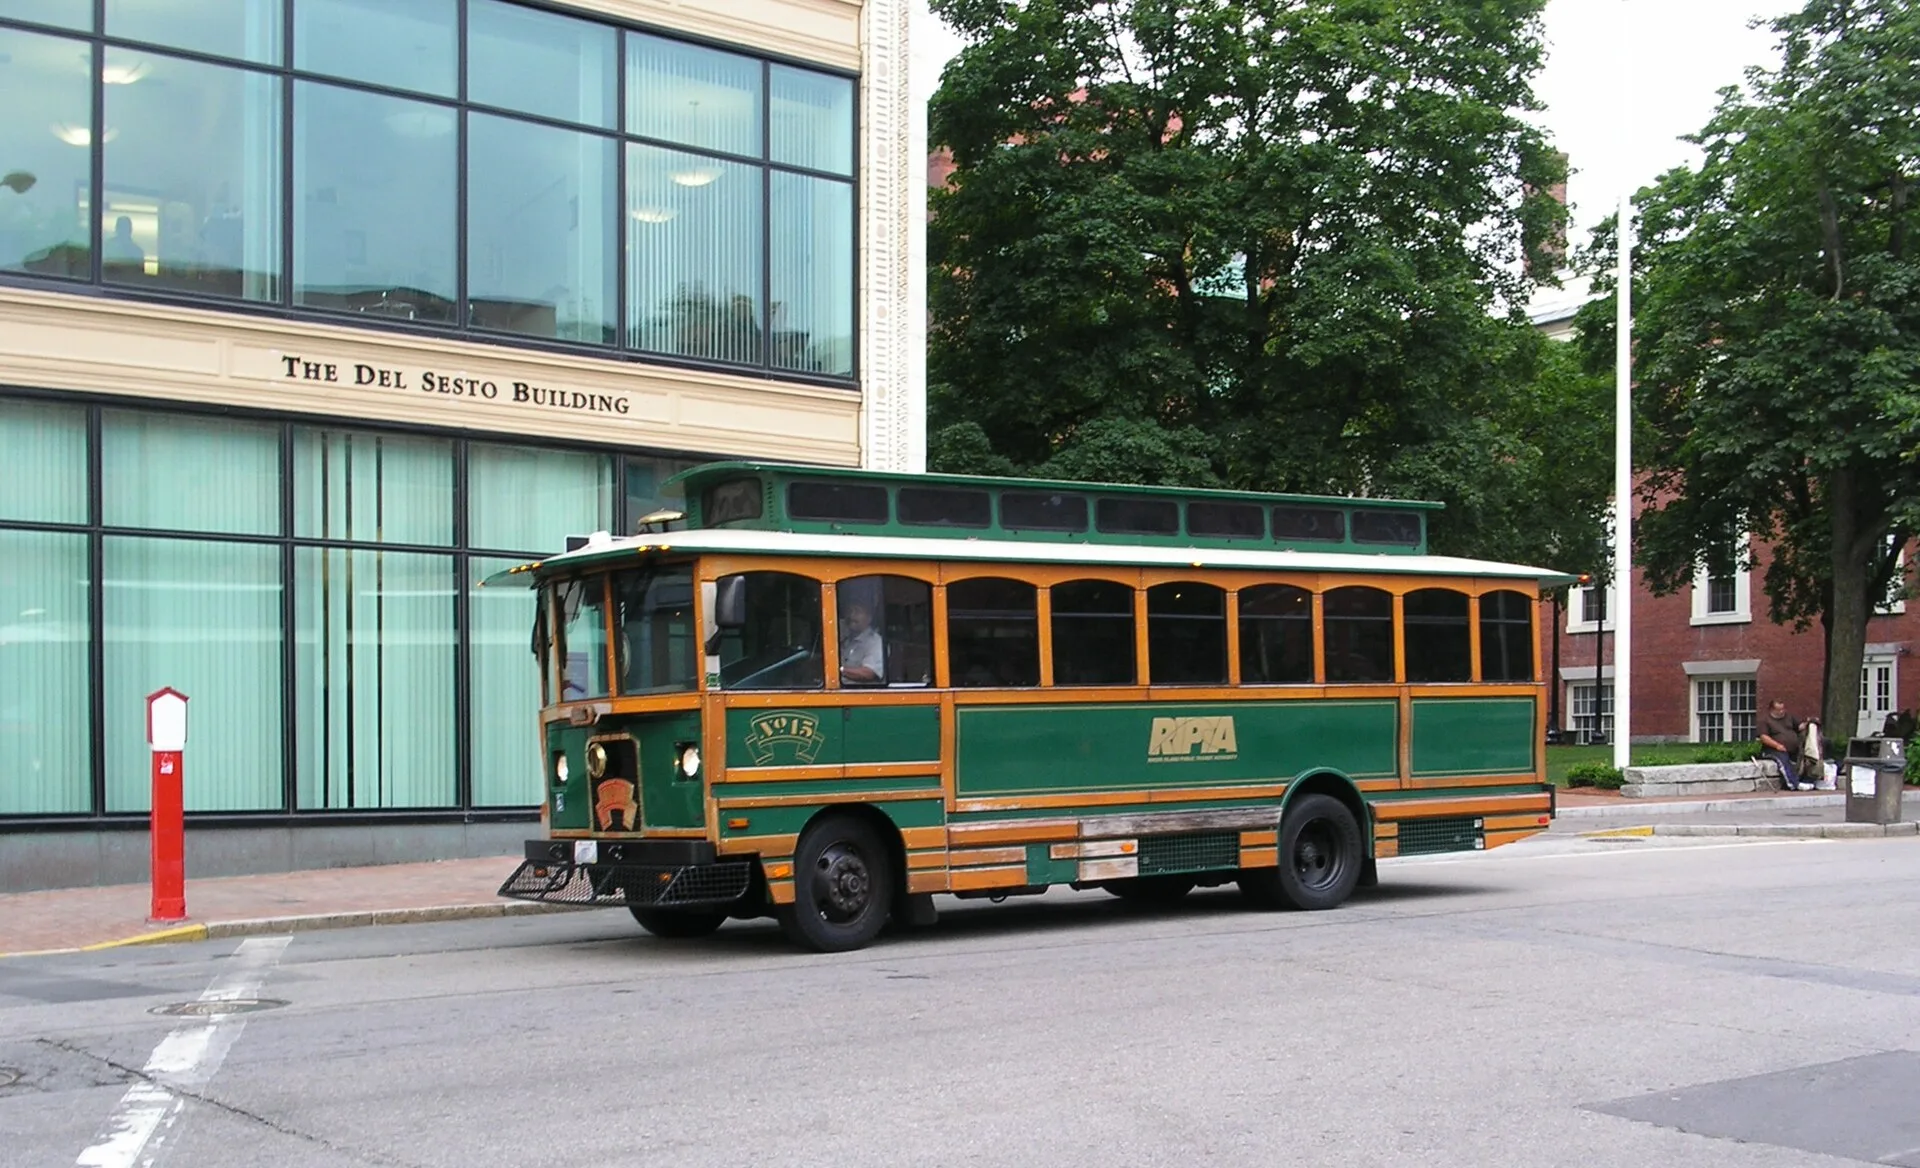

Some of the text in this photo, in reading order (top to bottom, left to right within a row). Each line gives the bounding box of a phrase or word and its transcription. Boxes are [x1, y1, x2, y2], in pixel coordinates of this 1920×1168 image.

[281, 354, 630, 415] THE DEL SESTO BUILDING
[790, 718, 813, 737] 15
